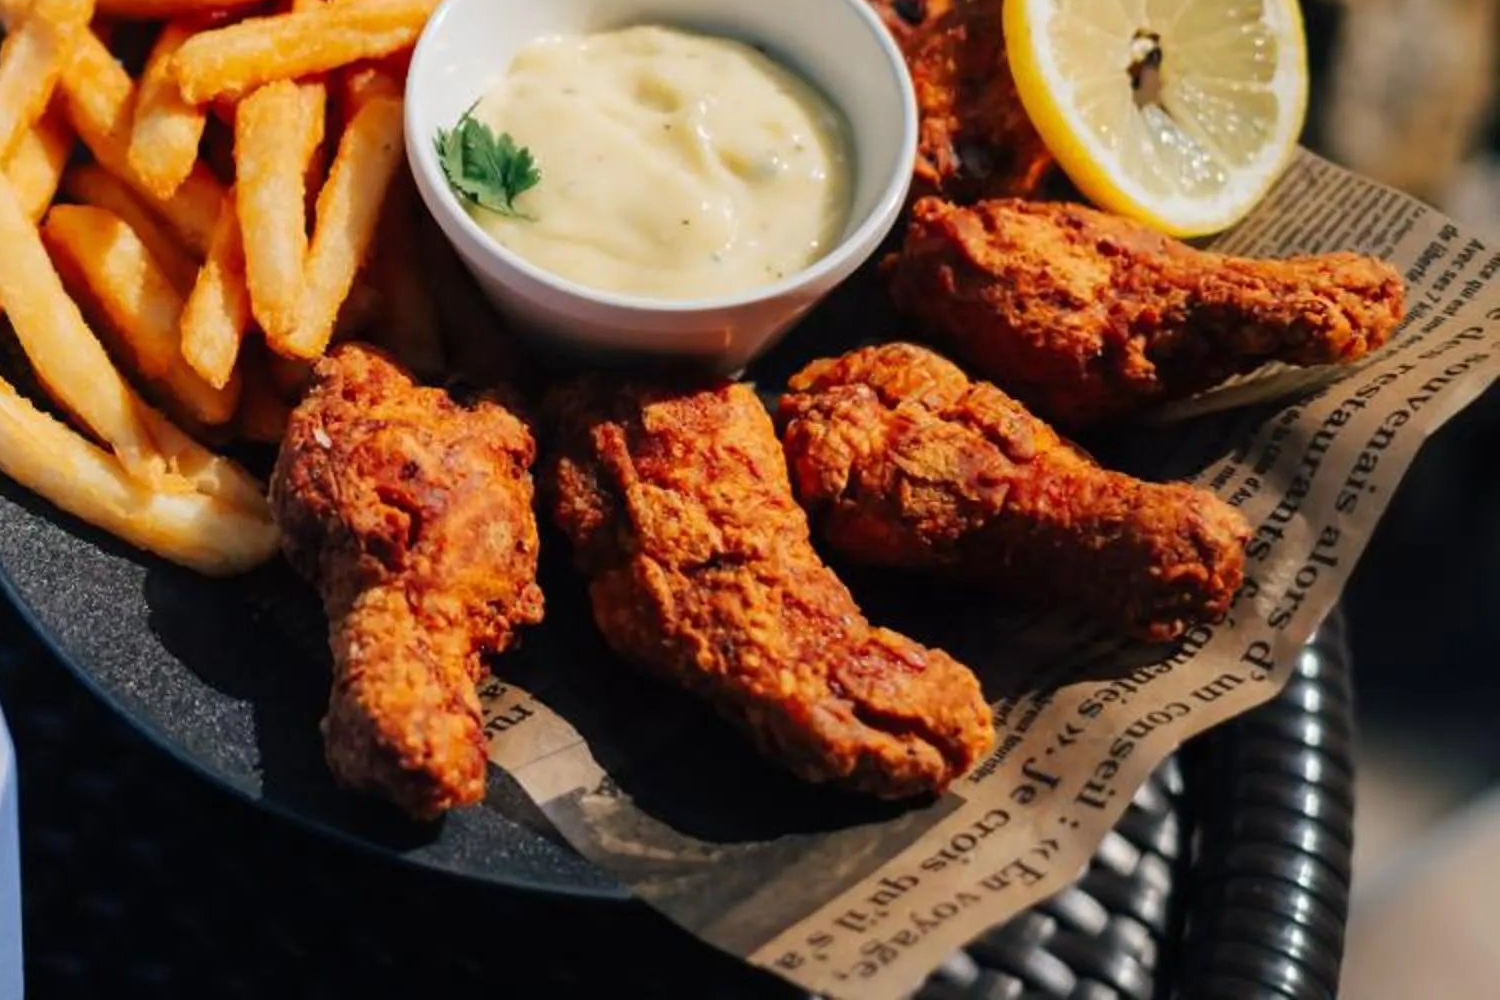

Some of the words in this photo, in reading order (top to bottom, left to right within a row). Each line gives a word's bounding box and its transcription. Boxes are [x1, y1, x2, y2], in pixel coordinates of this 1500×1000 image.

[1245, 363, 1416, 562] restaurants
[1267, 525, 1341, 630] alors
[1010, 756, 1062, 804] Je
[1073, 701, 1192, 809] conseil
[919, 808, 1011, 873] crois
[978, 857, 1046, 889] En
